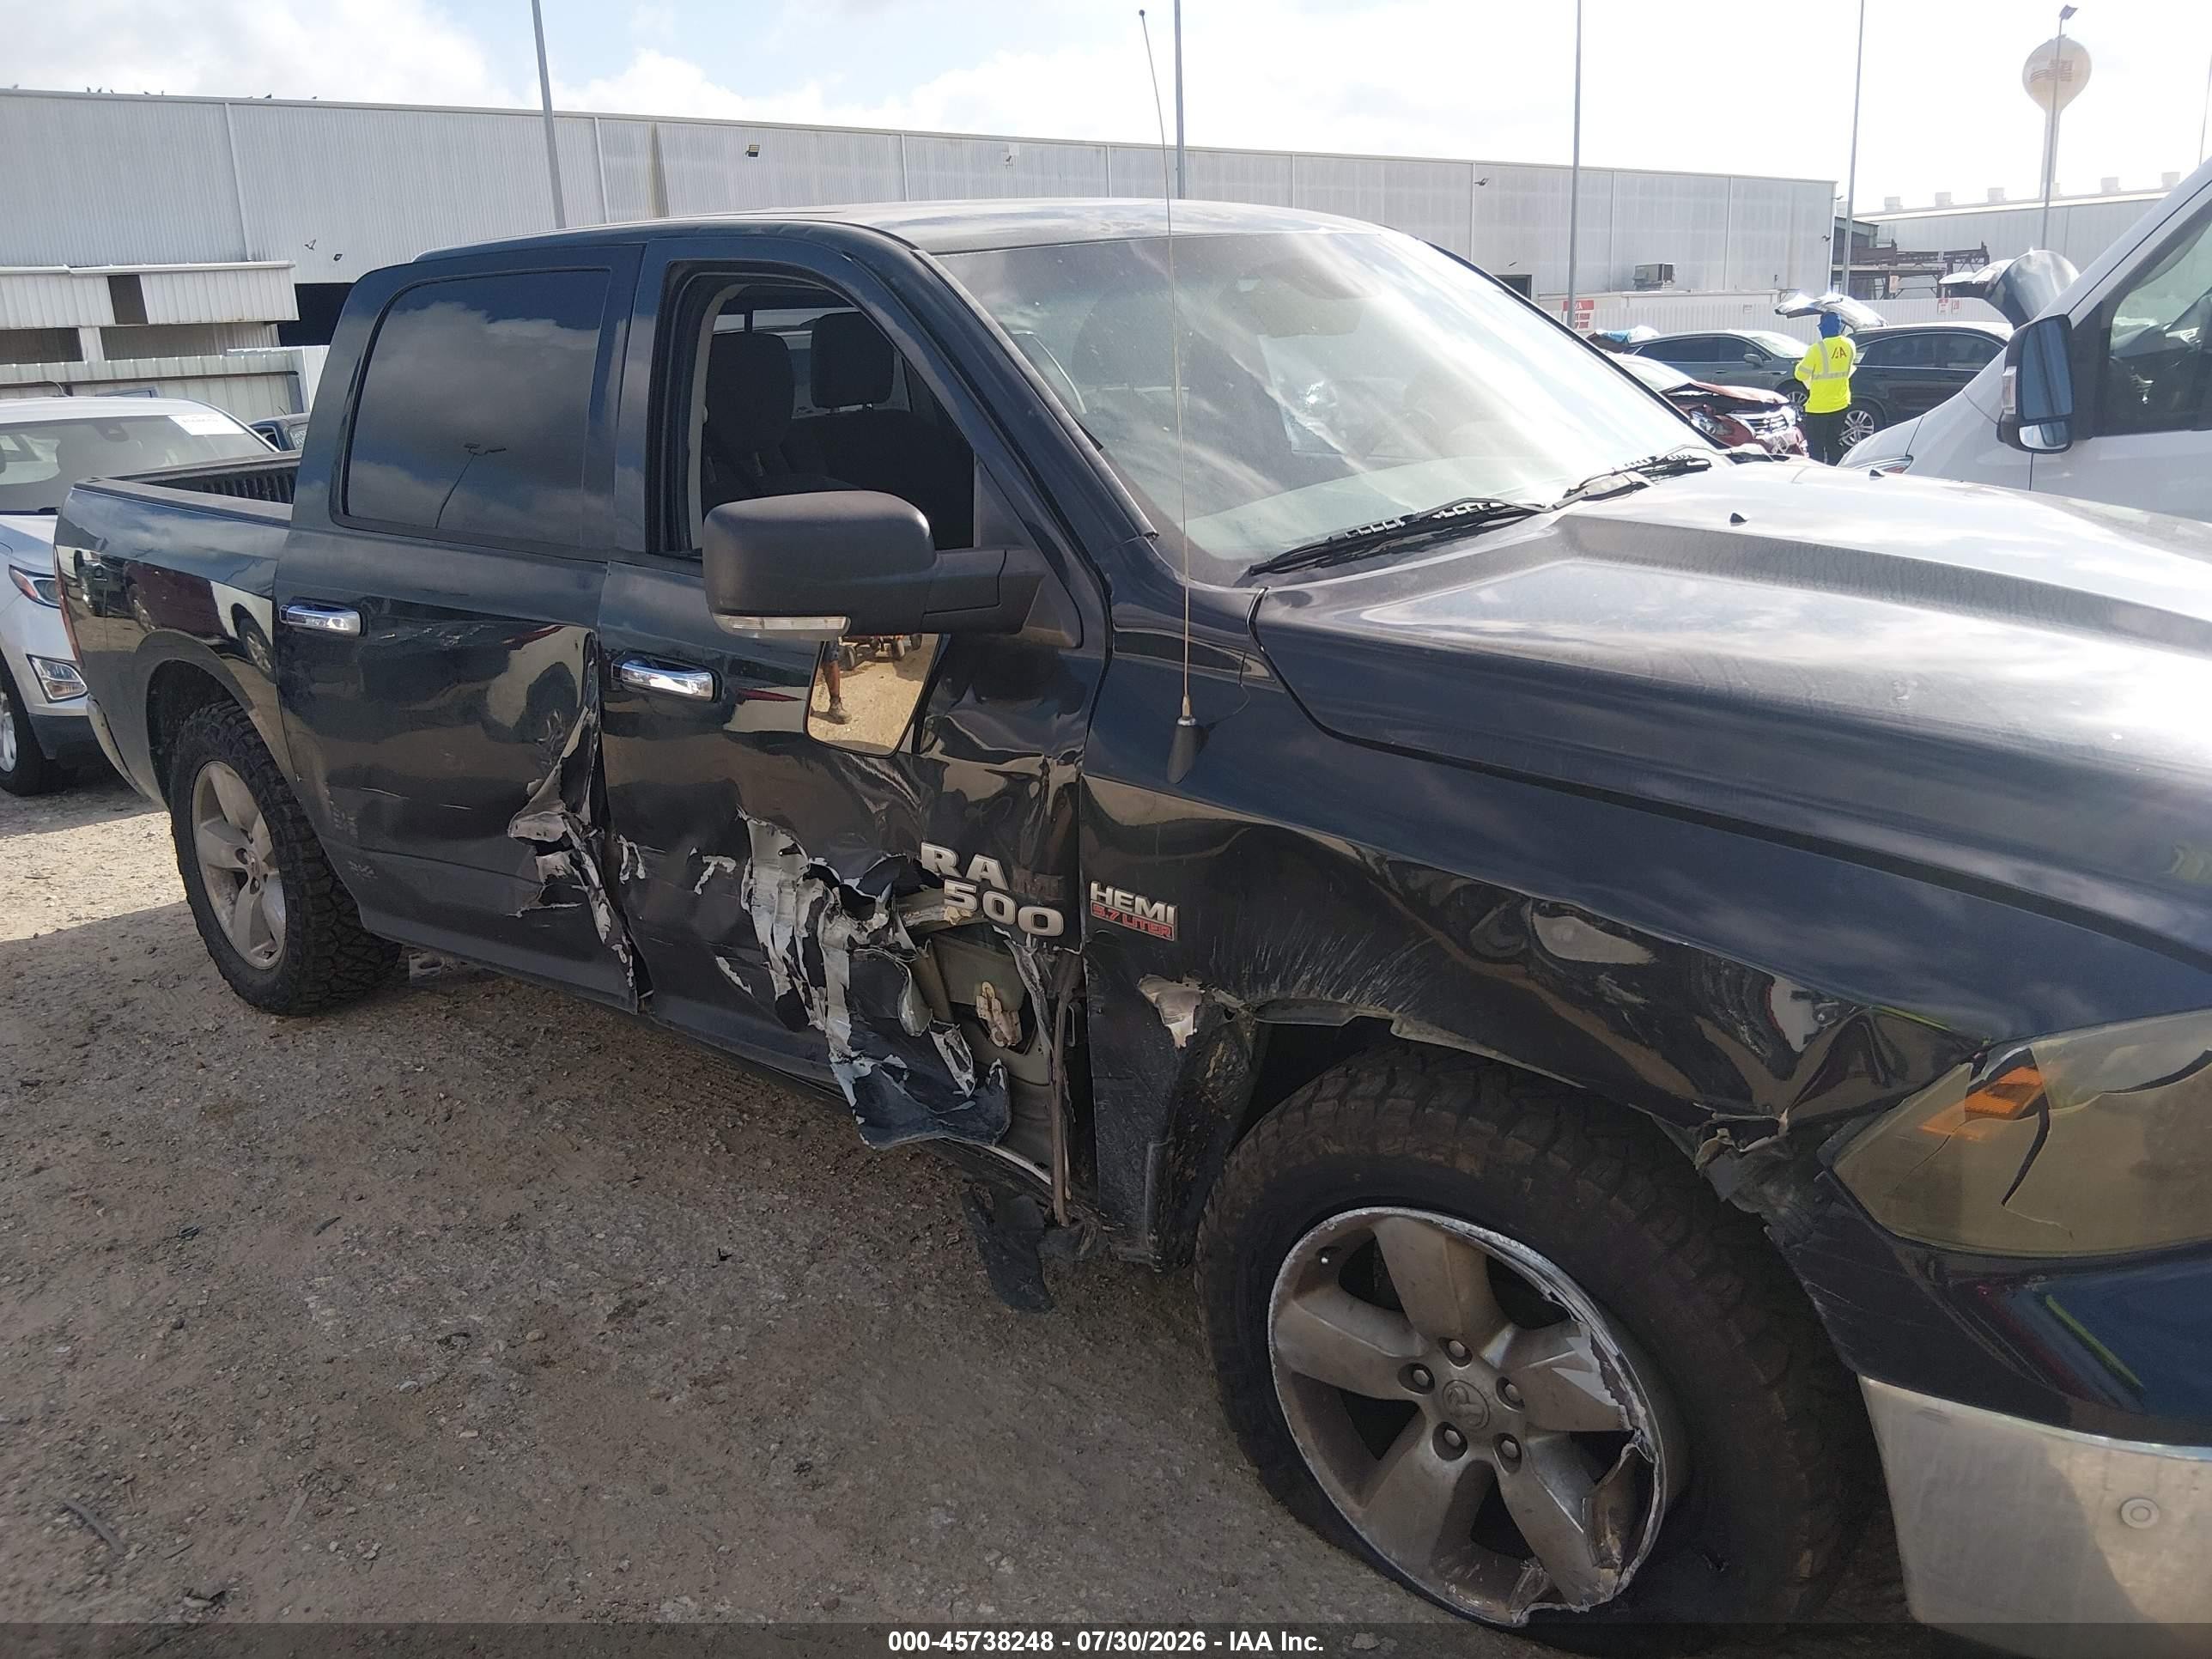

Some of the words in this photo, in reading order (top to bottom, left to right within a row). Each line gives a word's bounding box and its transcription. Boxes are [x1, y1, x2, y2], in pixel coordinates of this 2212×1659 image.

[944, 878, 1064, 937] 500
[1091, 881, 1178, 925] HEMI
[1092, 903, 1120, 921] 5.7
[1121, 913, 1171, 938] LITER
